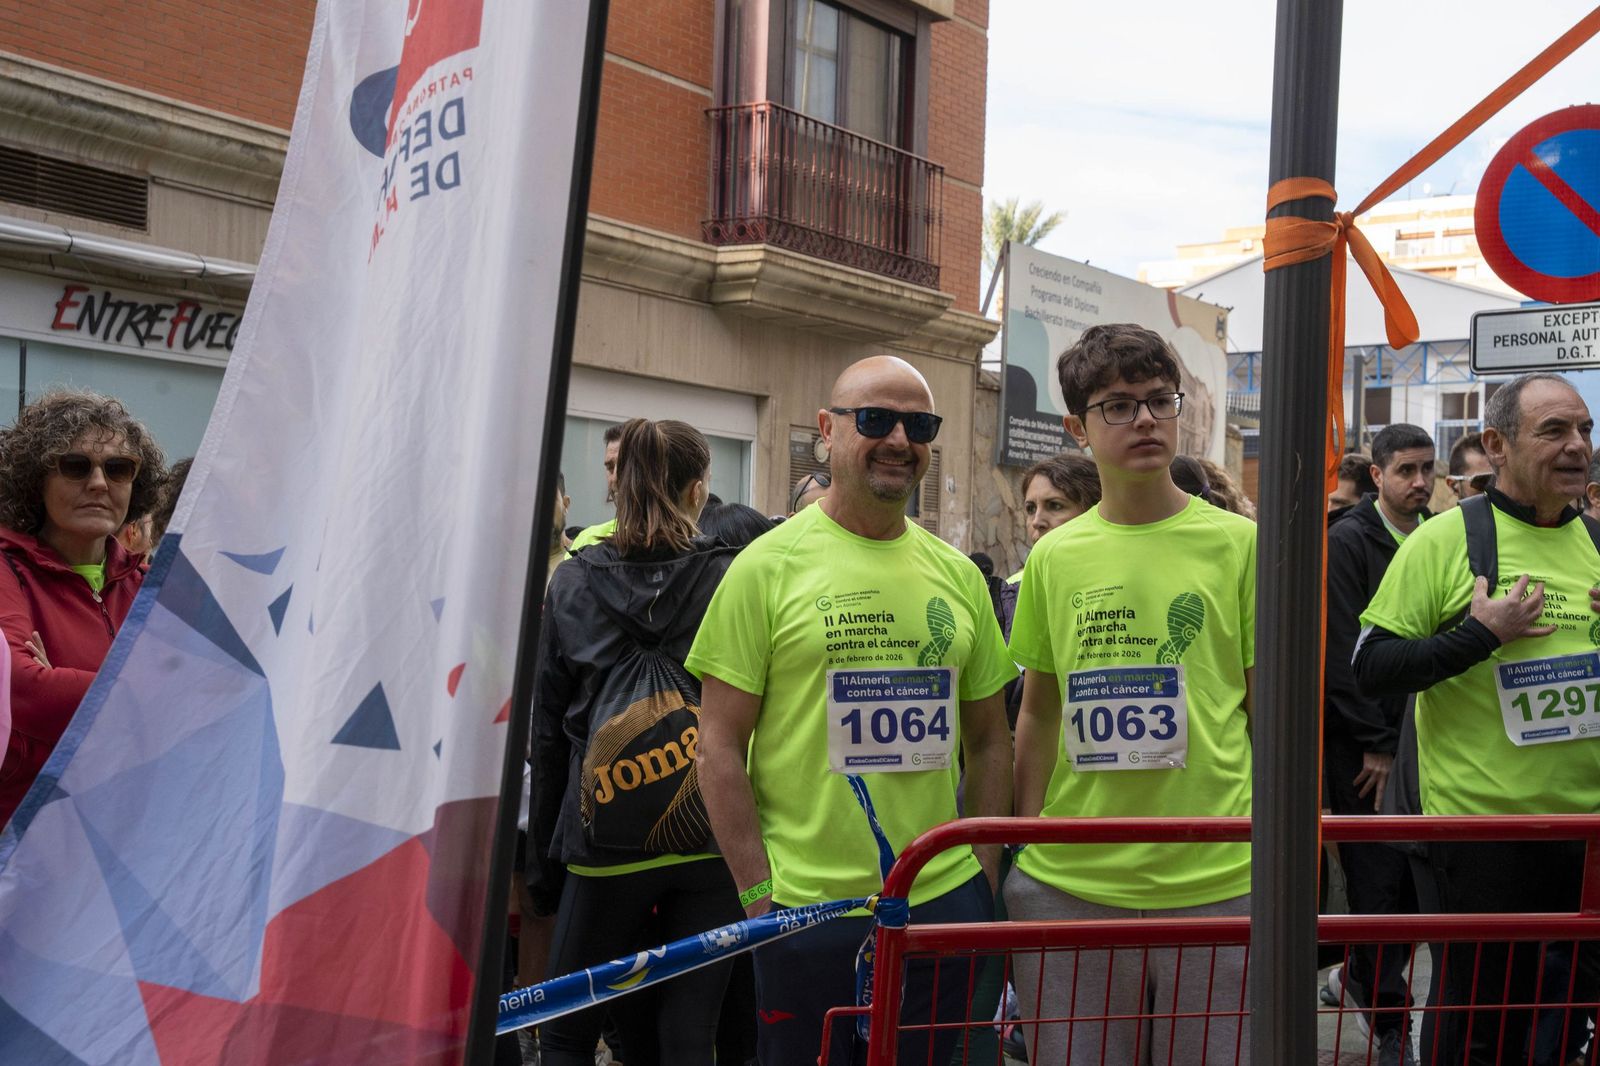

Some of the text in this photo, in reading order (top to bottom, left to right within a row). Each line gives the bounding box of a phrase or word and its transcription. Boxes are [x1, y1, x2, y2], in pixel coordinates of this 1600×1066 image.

[1029, 262, 1062, 283] Creciendo
[1063, 275, 1072, 285] en
[1031, 285, 1062, 304] Programa
[1493, 328, 1600, 348] PERSONAL AUT
[1557, 345, 1596, 360] D.G.T.
[824, 610, 895, 627] II Almería
[1085, 606, 1135, 623] Almería
[1545, 610, 1591, 621] el cáncer
[826, 625, 888, 639] en marcha
[1086, 621, 1126, 634] marcha
[826, 638, 920, 652] contra el cáncer
[1105, 634, 1116, 645] el
[1118, 634, 1158, 646] cáncer
[835, 655, 845, 663] de
[846, 654, 873, 662] febrero
[875, 653, 884, 661] de
[1087, 652, 1111, 660] febrero
[1121, 650, 1141, 658] 2026
[1514, 662, 1552, 674] Almería
[849, 675, 891, 686] Almería
[1077, 674, 1107, 686] Almería
[1108, 674, 1122, 683] en
[1124, 671, 1166, 682] marcha
[1513, 669, 1585, 684] contra el cáncer
[847, 687, 882, 697] contra
[884, 687, 894, 696] el
[896, 686, 929, 696] cáncer
[1075, 687, 1098, 697] contra
[1101, 685, 1110, 694] el
[1113, 684, 1150, 694] cáncer
[1511, 683, 1600, 722] 1297
[841, 706, 950, 744] 1064
[1071, 704, 1177, 743] 1063
[780, 919, 801, 933] de
